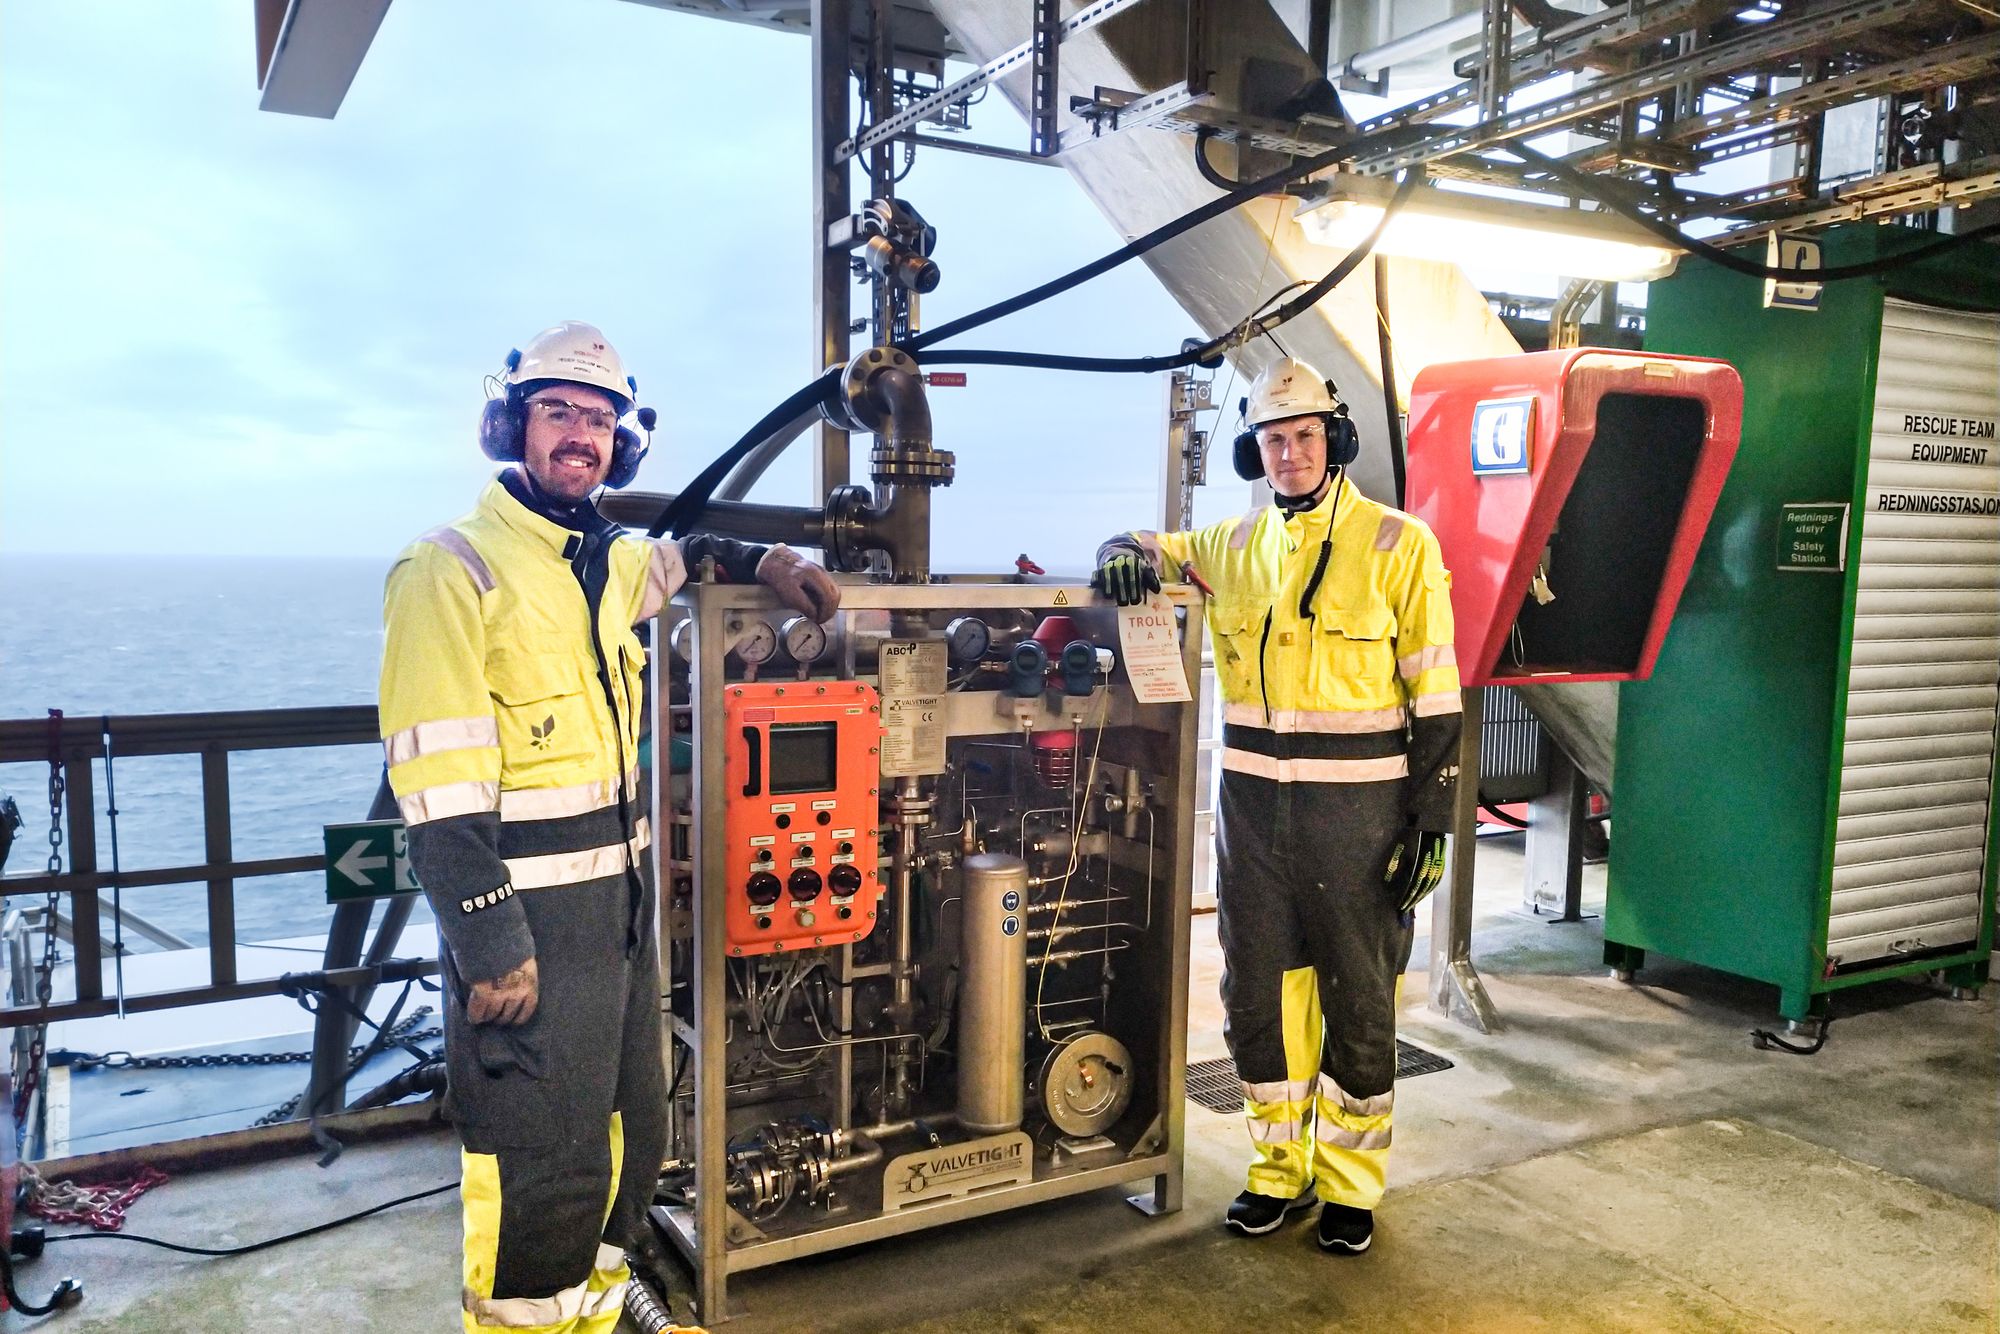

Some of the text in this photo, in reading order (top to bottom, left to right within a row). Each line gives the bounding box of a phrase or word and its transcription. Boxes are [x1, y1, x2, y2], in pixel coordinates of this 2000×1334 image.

[1904, 415, 1995, 439] RESCUE TEAM
[1911, 443, 1988, 465] EQUIPMENT
[1787, 512, 1837, 524] Rednings-
[1795, 525, 1825, 536] utstyr
[1793, 541, 1825, 553] Safety
[1791, 553, 1826, 563] Station
[1128, 615, 1169, 628] TROLL
[1147, 631, 1154, 640] A
[901, 698, 938, 706] VALVETIGHT
[922, 712, 933, 722] CE
[930, 1142, 1023, 1174] VALVETIGHT
